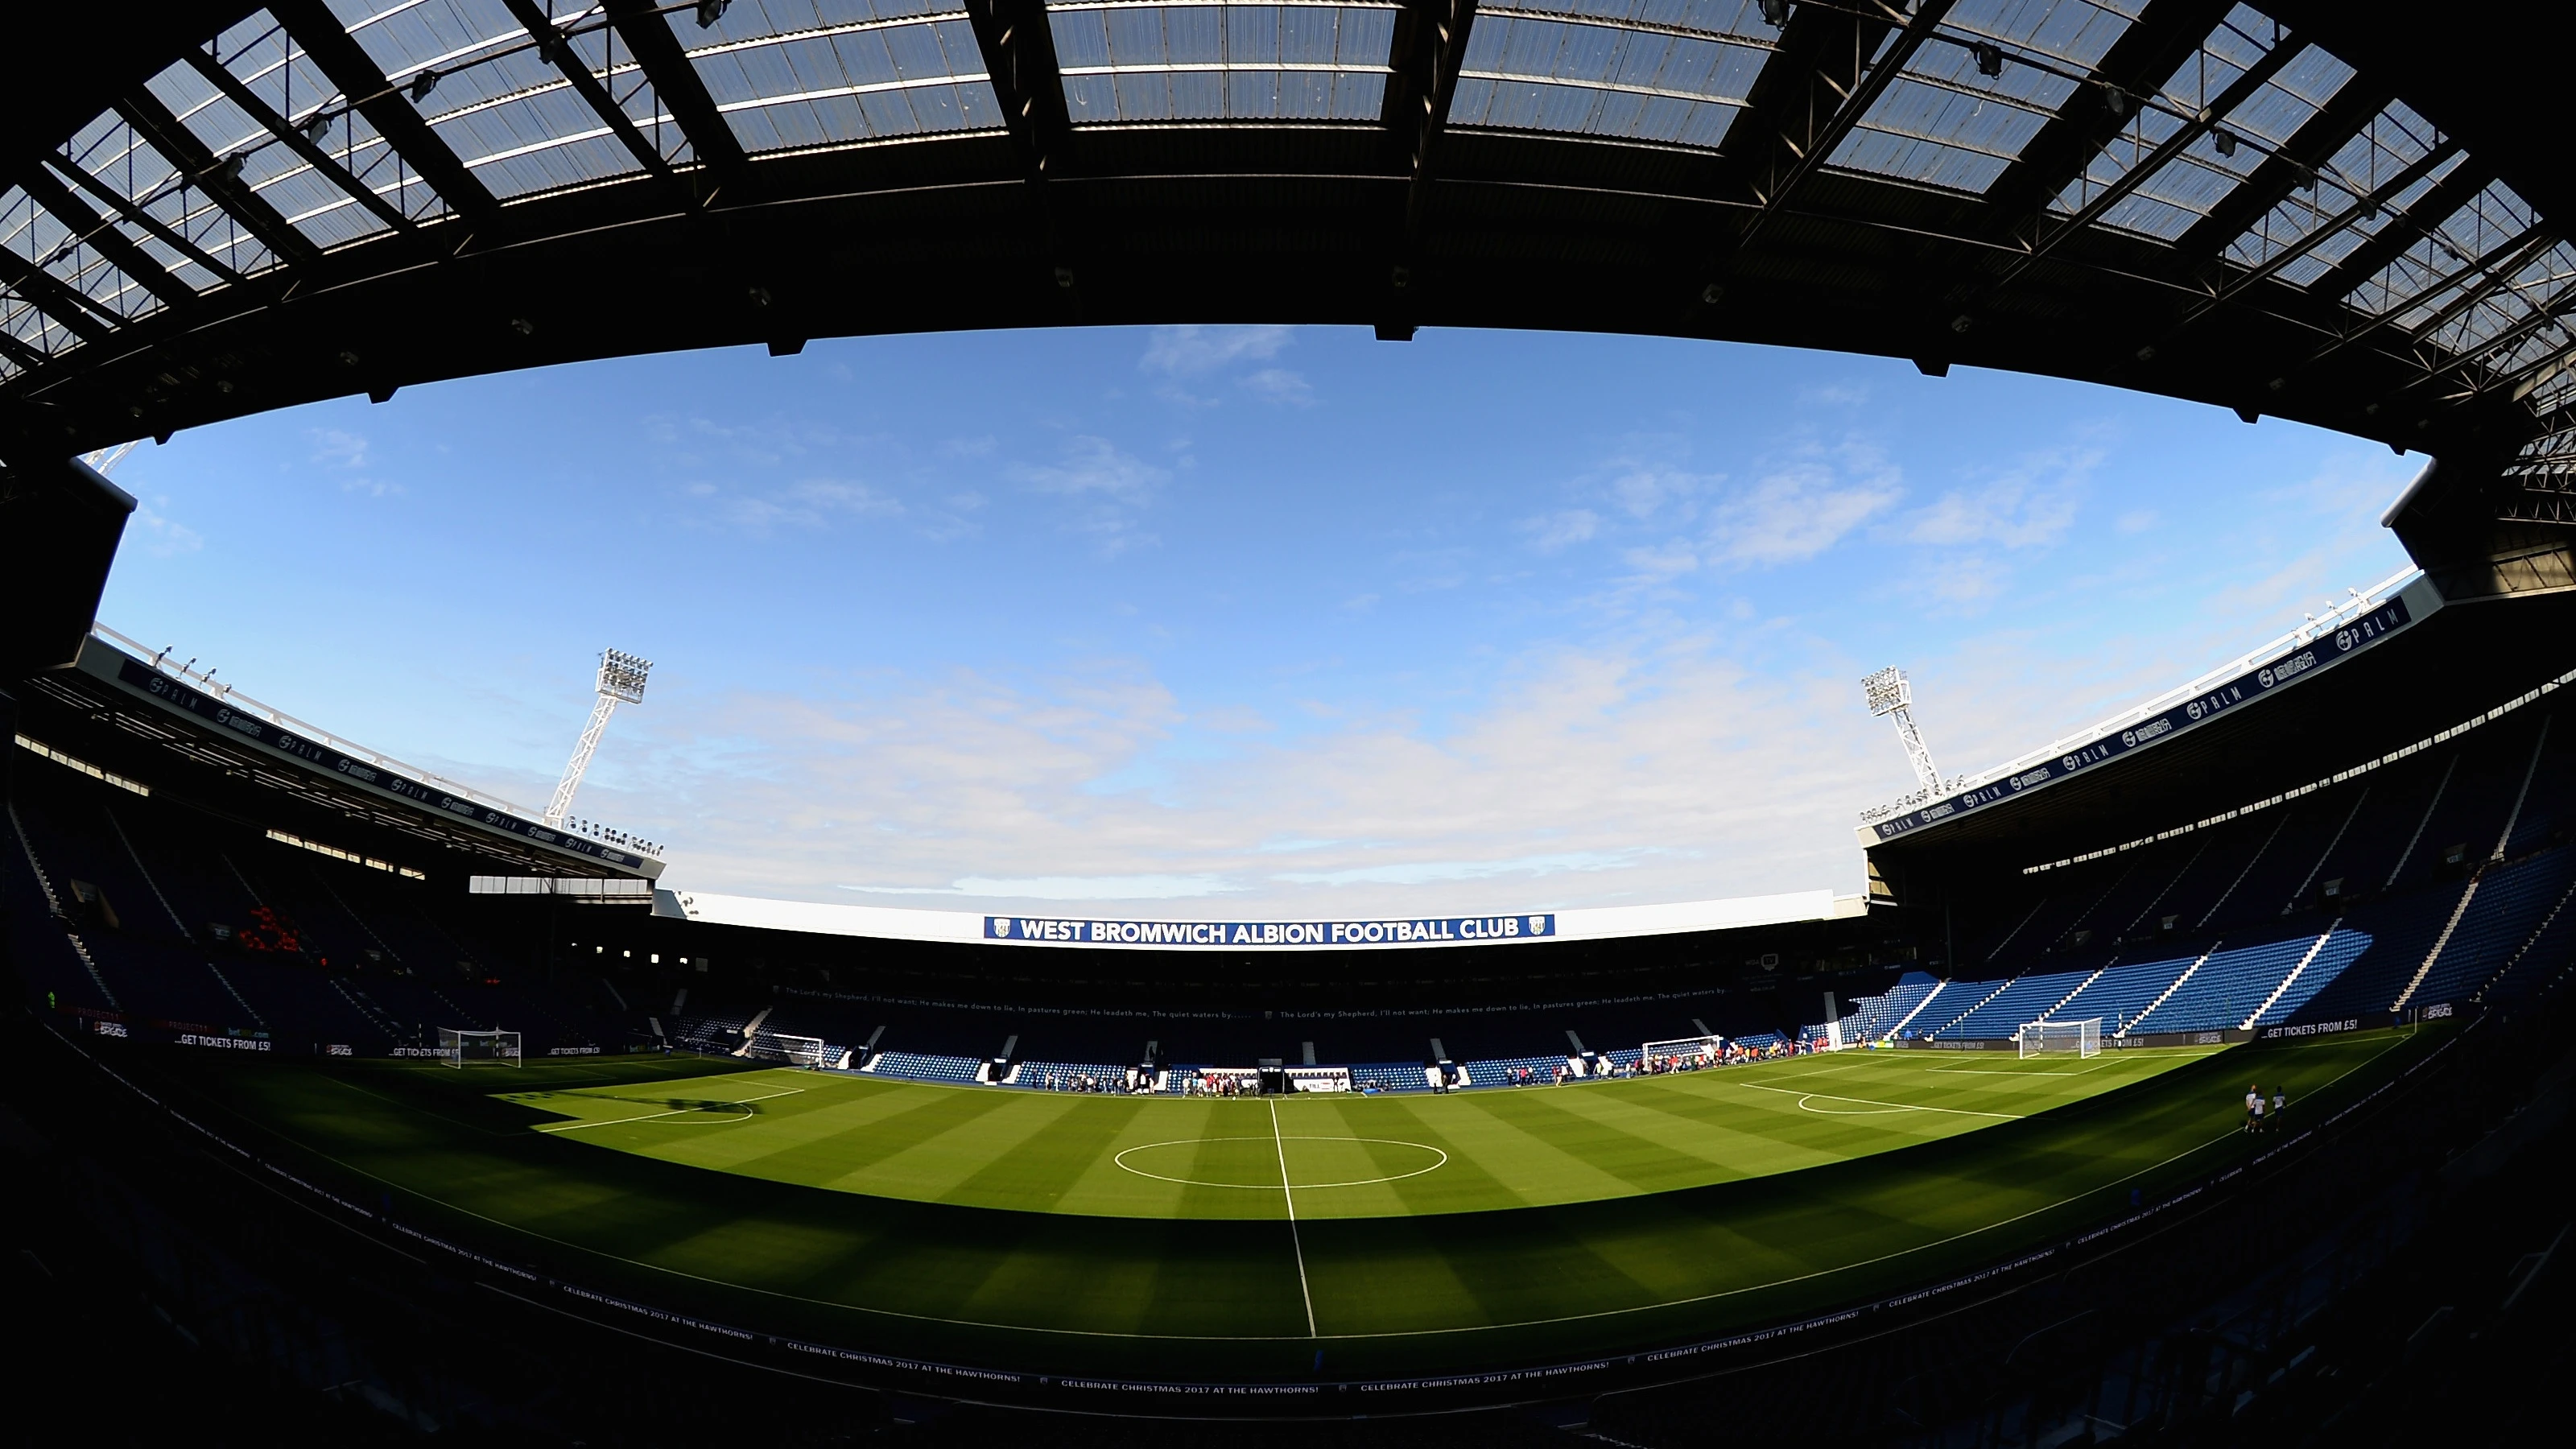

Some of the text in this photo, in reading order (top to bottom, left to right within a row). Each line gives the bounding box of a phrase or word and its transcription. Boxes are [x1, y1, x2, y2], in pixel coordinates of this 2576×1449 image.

[2351, 609, 2398, 643] PALM
[162, 685, 198, 712] PALM
[2200, 686, 2241, 714] PALM
[2074, 745, 2108, 766] PALM
[1020, 918, 1519, 943] WEST BROMWICH ALBION FOOTBALL CLUB
[799, 989, 820, 997] Lord's
[1542, 1002, 1574, 1010] pastures
[1613, 995, 1641, 1003] leadeth
[1672, 991, 1690, 999] quiet
[2285, 1024, 2316, 1037] TICKETS
[2318, 1022, 2342, 1034] FROM
[2343, 1019, 2357, 1030] £5!
[199, 1036, 232, 1048] TICKETS
[233, 1038, 256, 1050] FROM
[258, 1041, 270, 1051] £5!
[407, 1048, 432, 1056] TICETS
[433, 1048, 450, 1056] FROM
[2114, 1038, 2132, 1047] FOM
[2133, 1038, 2144, 1046] £5!
[1889, 1290, 1930, 1307] CELEBRATE
[1931, 1278, 1971, 1294] CHRISTMAS
[1973, 1273, 1989, 1282] 2017
[2014, 1249, 2054, 1267] HAWTHORNS!
[564, 1286, 602, 1302] CELEBRATE
[605, 1298, 648, 1315] CHRISTMAS
[650, 1311, 668, 1320] 2017
[682, 1319, 696, 1327] THE
[699, 1323, 753, 1340] HAWTHORNS!
[1647, 1347, 1697, 1361] CELEBRATE
[1701, 1336, 1752, 1352] CHRISTMAS
[1754, 1331, 1774, 1341] 2017
[1790, 1325, 1803, 1333] THE
[1806, 1311, 1859, 1329] HAWTHORNS!
[787, 1343, 836, 1356] CELEBRATE
[840, 1352, 893, 1366] CHRISTMAS
[896, 1360, 919, 1369] 2017
[935, 1366, 952, 1374] THE
[956, 1369, 1020, 1381] HAWTHORNS!
[1061, 1381, 1117, 1389] CELEBRATE
[1121, 1384, 1181, 1392] CHRISTMAS
[1360, 1382, 1418, 1391] CELEBRATE
[1422, 1377, 1480, 1388] CHRISTMAS
[1484, 1374, 1507, 1383] 2017
[1525, 1370, 1542, 1378] THE
[1546, 1362, 1608, 1376] HAWTHORNS!
